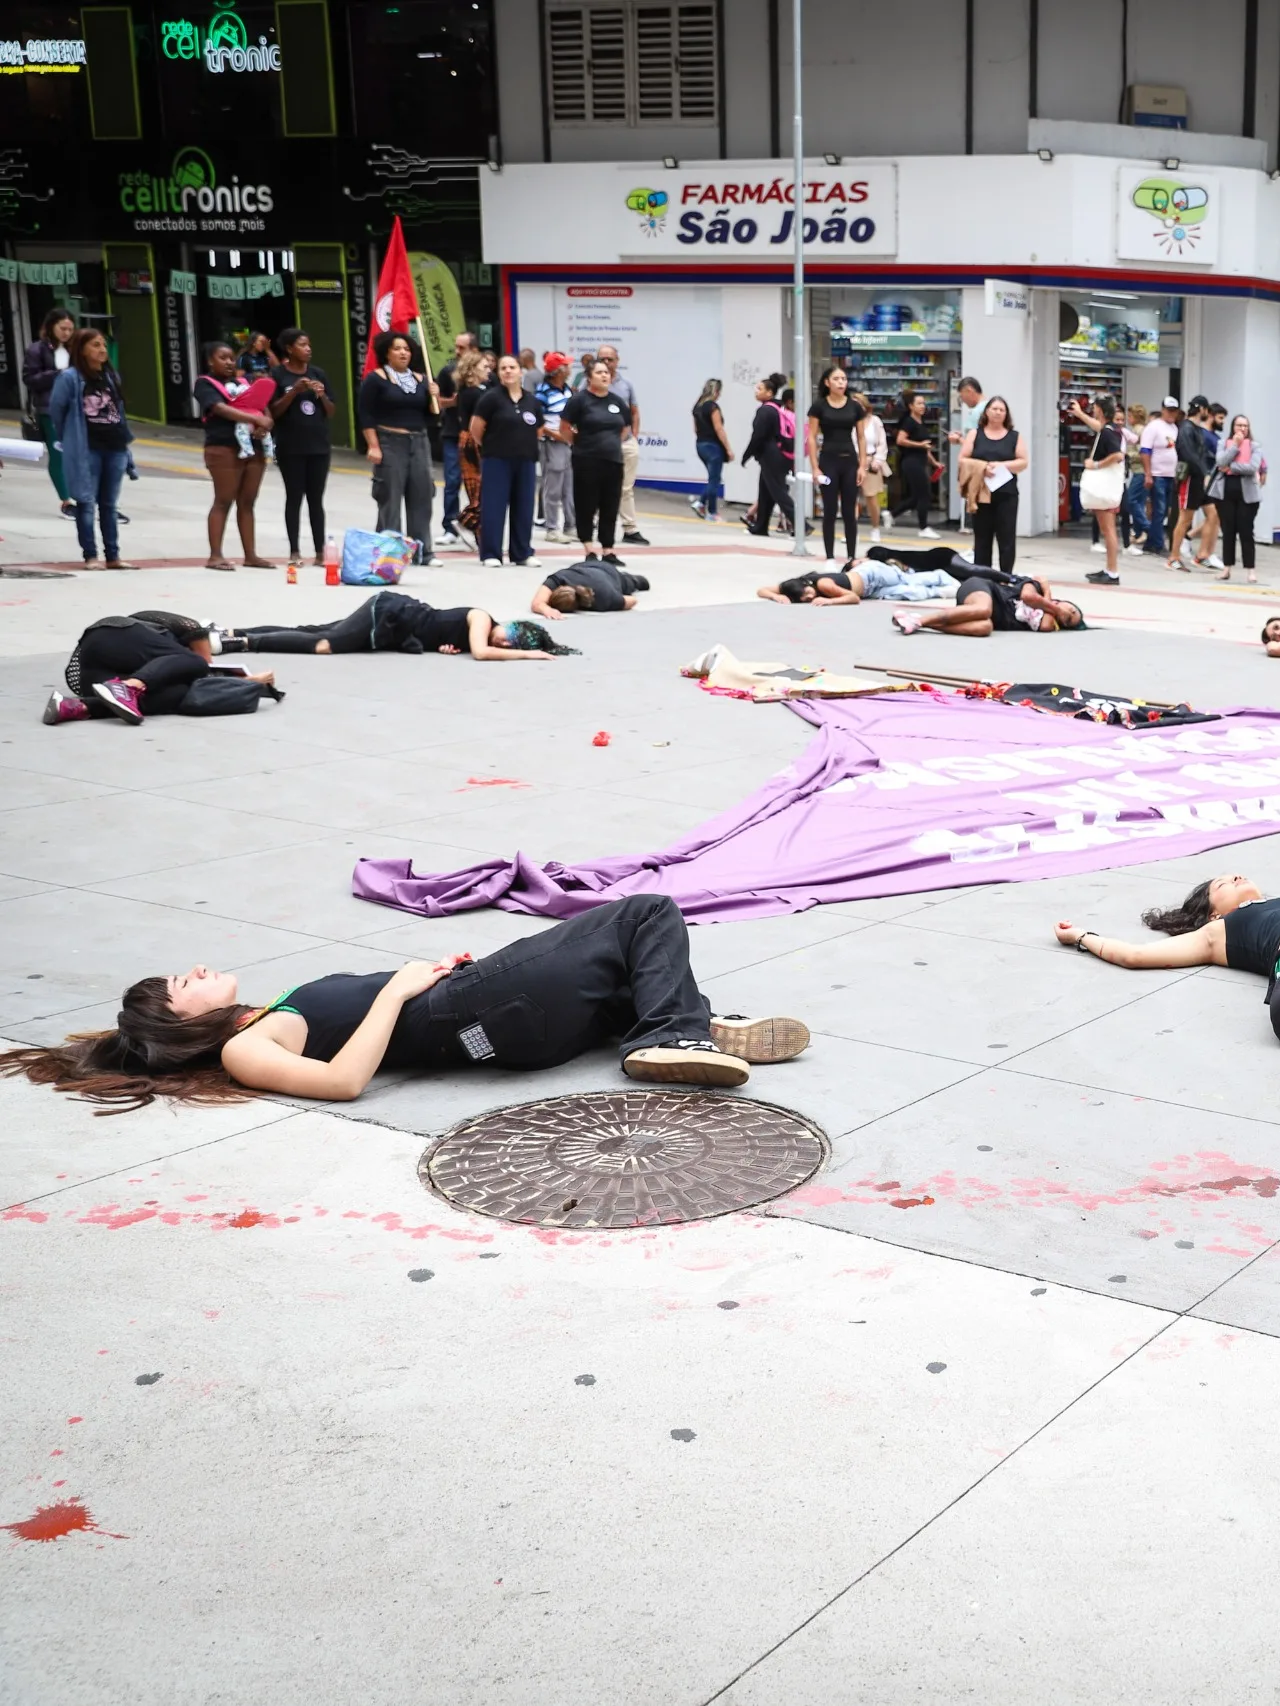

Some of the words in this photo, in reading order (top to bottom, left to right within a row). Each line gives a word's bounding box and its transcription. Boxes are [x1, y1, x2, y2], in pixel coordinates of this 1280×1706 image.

[162, 18, 193, 35] rede
[119, 170, 150, 186] rede
[120, 174, 274, 213] celltronics
[680, 177, 869, 205] FARMÁCIAS
[134, 217, 198, 231] conectados
[201, 220, 236, 231] somos
[676, 208, 758, 244] São
[770, 208, 875, 244] João
[173, 277, 197, 293] NO
[211, 281, 284, 298] BOLETO
